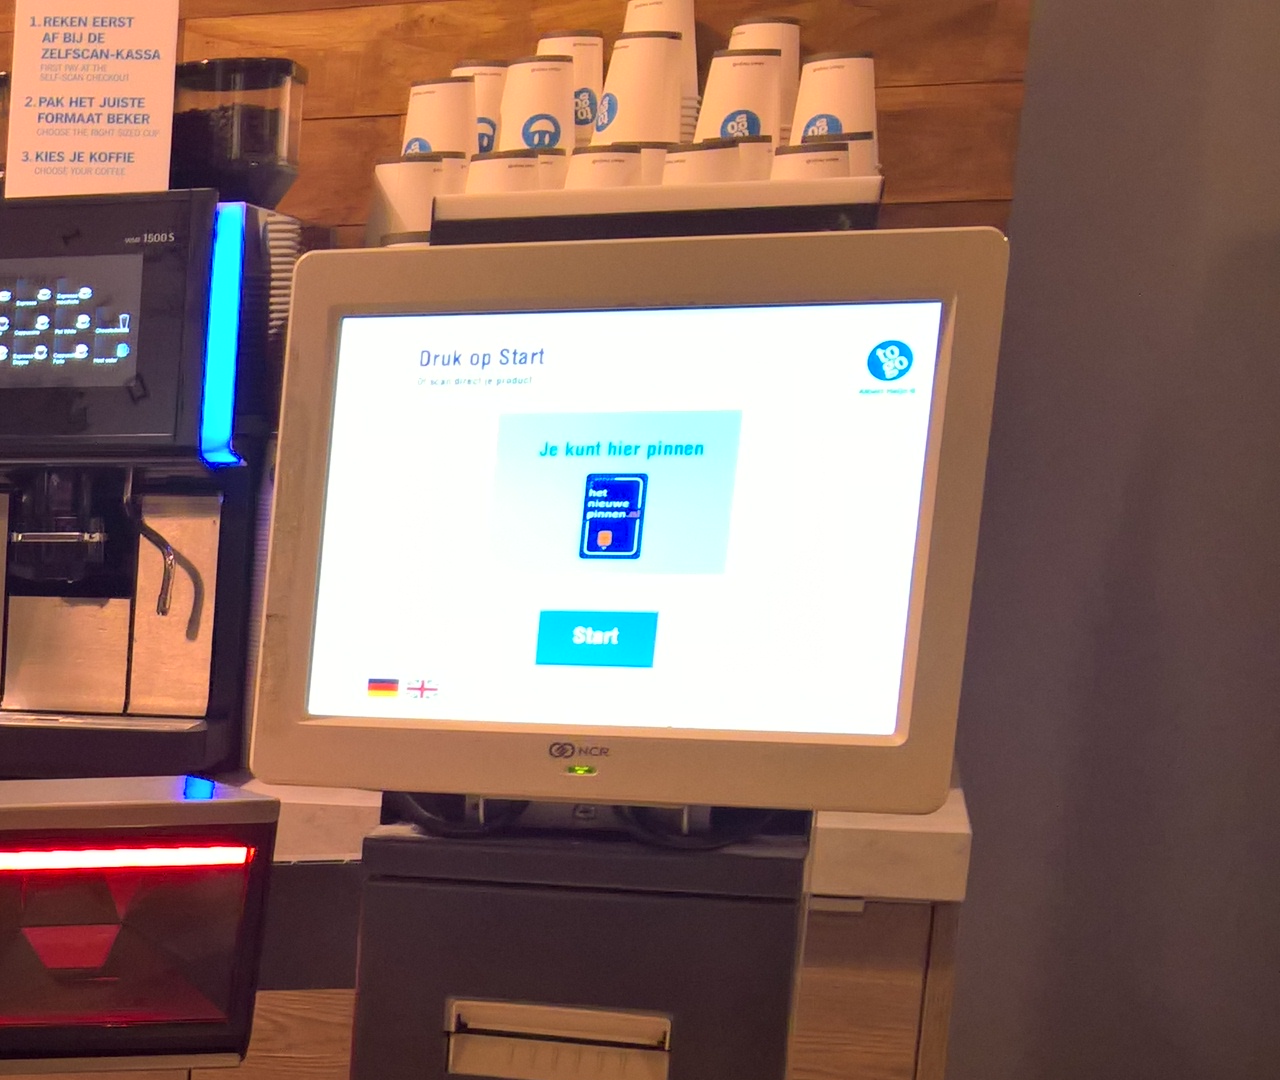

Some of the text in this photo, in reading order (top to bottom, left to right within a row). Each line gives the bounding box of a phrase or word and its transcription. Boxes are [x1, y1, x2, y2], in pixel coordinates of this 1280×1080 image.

[43, 16, 88, 28] REKEN
[92, 16, 135, 28] EERST
[42, 32, 105, 44] AF BIJ DE
[41, 48, 161, 60] ZELFSCAN-KASSA
[40, 64, 62, 72] FIRST
[92, 64, 107, 72] THE
[86, 74, 129, 82] CHECKOUT
[38, 97, 64, 108] PAK
[69, 97, 95, 108] HET
[99, 97, 145, 109] JUISTE
[37, 113, 150, 125] FORMAAT BEKER
[35, 152, 65, 163] KIES
[69, 152, 85, 163] JE
[89, 152, 135, 163] KOFFIE
[420, 348, 545, 370] Druk op Start
[875, 344, 900, 364] to
[539, 440, 704, 460] Je kunt hier pinnen
[588, 488, 608, 498] het
[587, 499, 630, 508] nieuwe
[572, 625, 620, 645] Start
[578, 746, 610, 757] NCR
